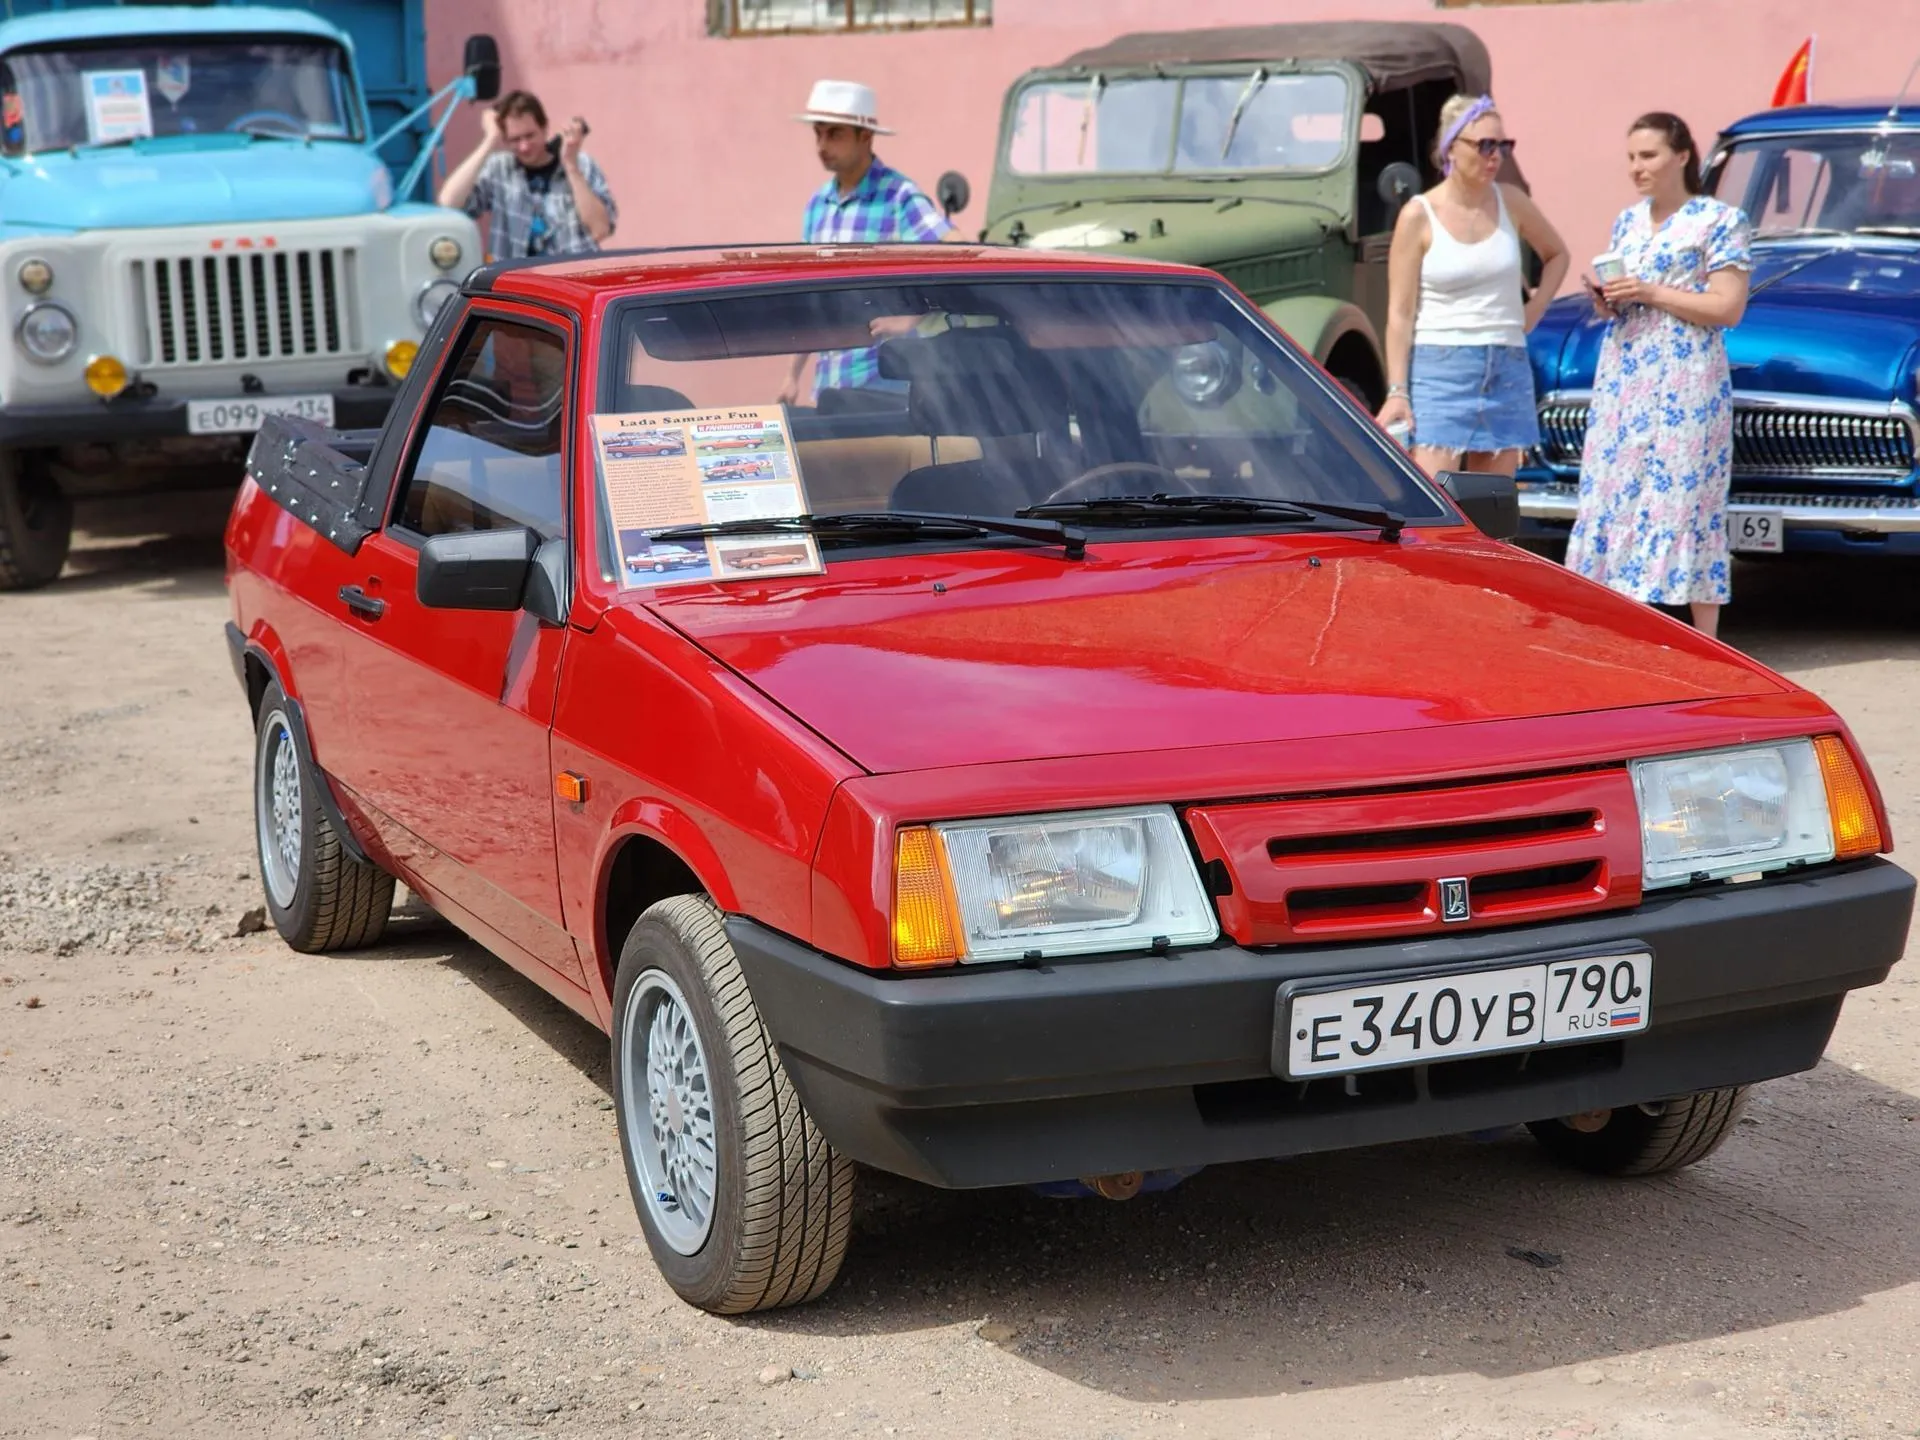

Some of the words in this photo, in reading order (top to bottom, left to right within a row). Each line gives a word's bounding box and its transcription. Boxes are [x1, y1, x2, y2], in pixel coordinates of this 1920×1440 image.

[620, 417, 657, 427] Lada
[663, 413, 722, 425] Samara
[728, 411, 759, 420] Fun
[1743, 516, 1771, 538] 69
[1310, 987, 1537, 1063] Е340УВ
[1554, 960, 1636, 1013] 790
[1568, 1009, 1608, 1031] RUS
